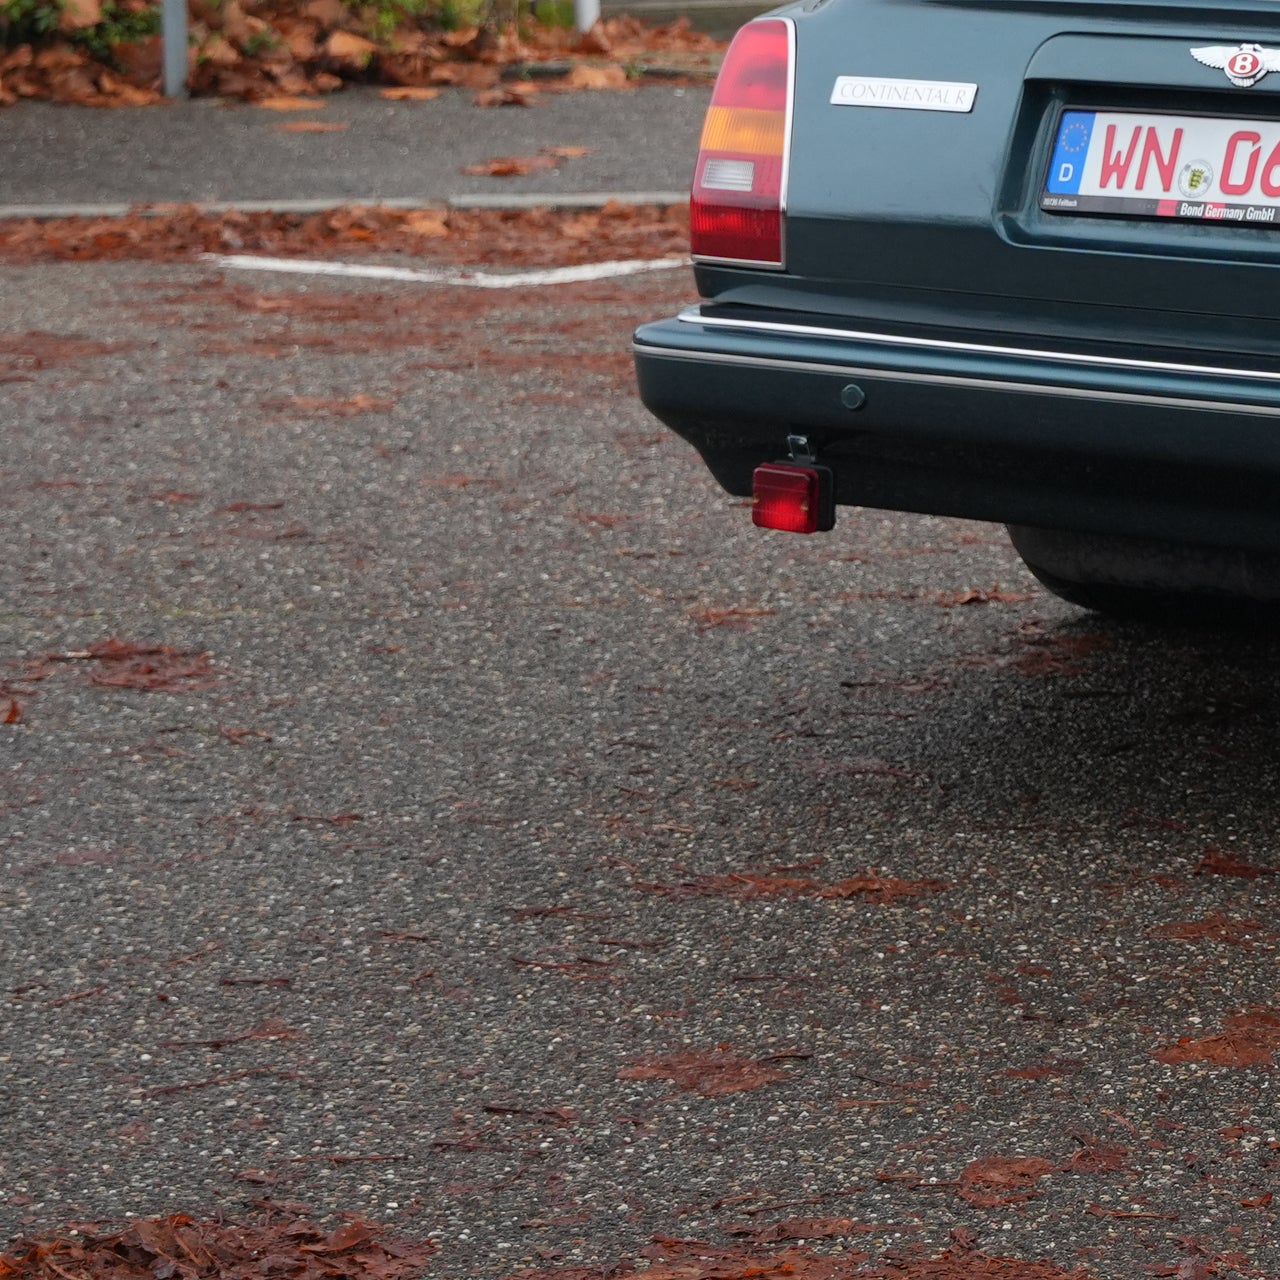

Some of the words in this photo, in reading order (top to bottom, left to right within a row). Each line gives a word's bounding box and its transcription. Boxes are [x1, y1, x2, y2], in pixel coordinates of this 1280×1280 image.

[1233, 53, 1254, 74] B
[840, 83, 950, 104] CONTINENTAL
[955, 89, 967, 105] R
[1099, 124, 1184, 192] WN
[1058, 163, 1074, 182] D
[1180, 203, 1204, 216] Bond
[1205, 204, 1245, 221] Germany
[1246, 207, 1276, 221] GmbH
